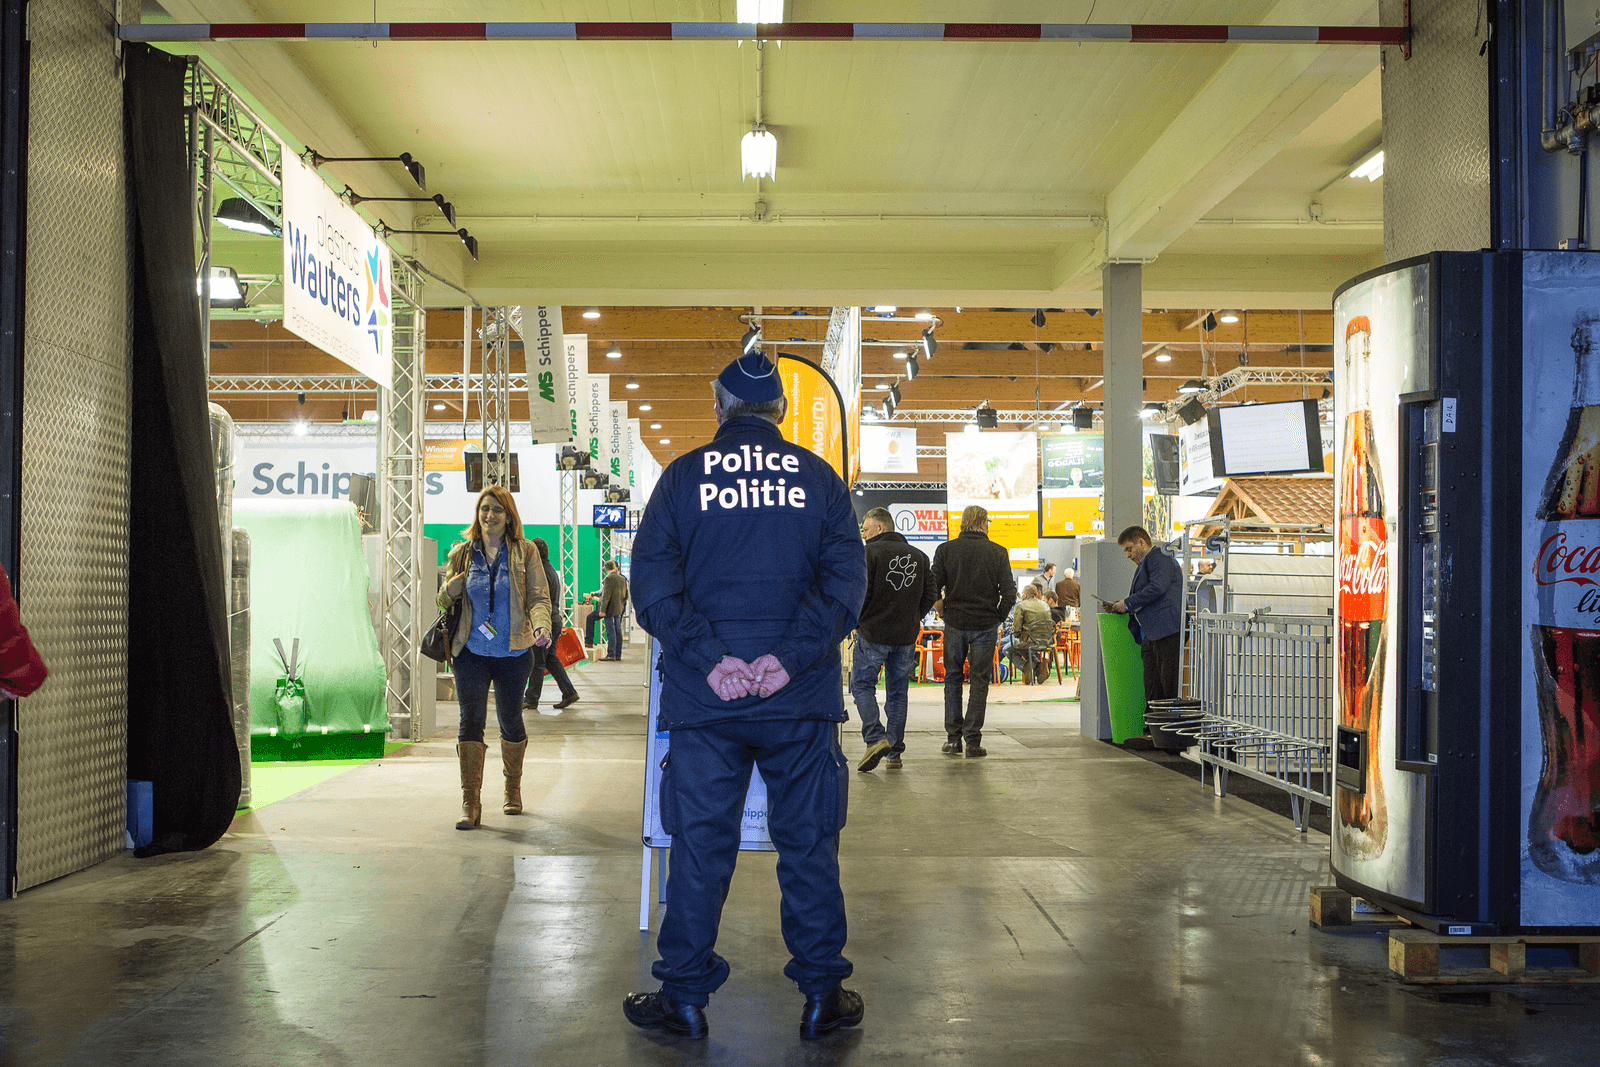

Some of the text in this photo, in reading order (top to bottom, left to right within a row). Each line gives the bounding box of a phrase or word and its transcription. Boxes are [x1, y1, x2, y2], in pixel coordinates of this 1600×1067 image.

[317, 209, 359, 276] plastics
[288, 220, 360, 326] Wauters
[567, 344, 578, 405] Schippers
[589, 382, 599, 434] Schippers
[425, 445, 458, 453] Winnaar
[610, 408, 620, 454] Schippers
[252, 460, 445, 500] Schips
[704, 445, 799, 475] Police
[699, 478, 806, 511] Politie
[918, 521, 948, 532] NAE
